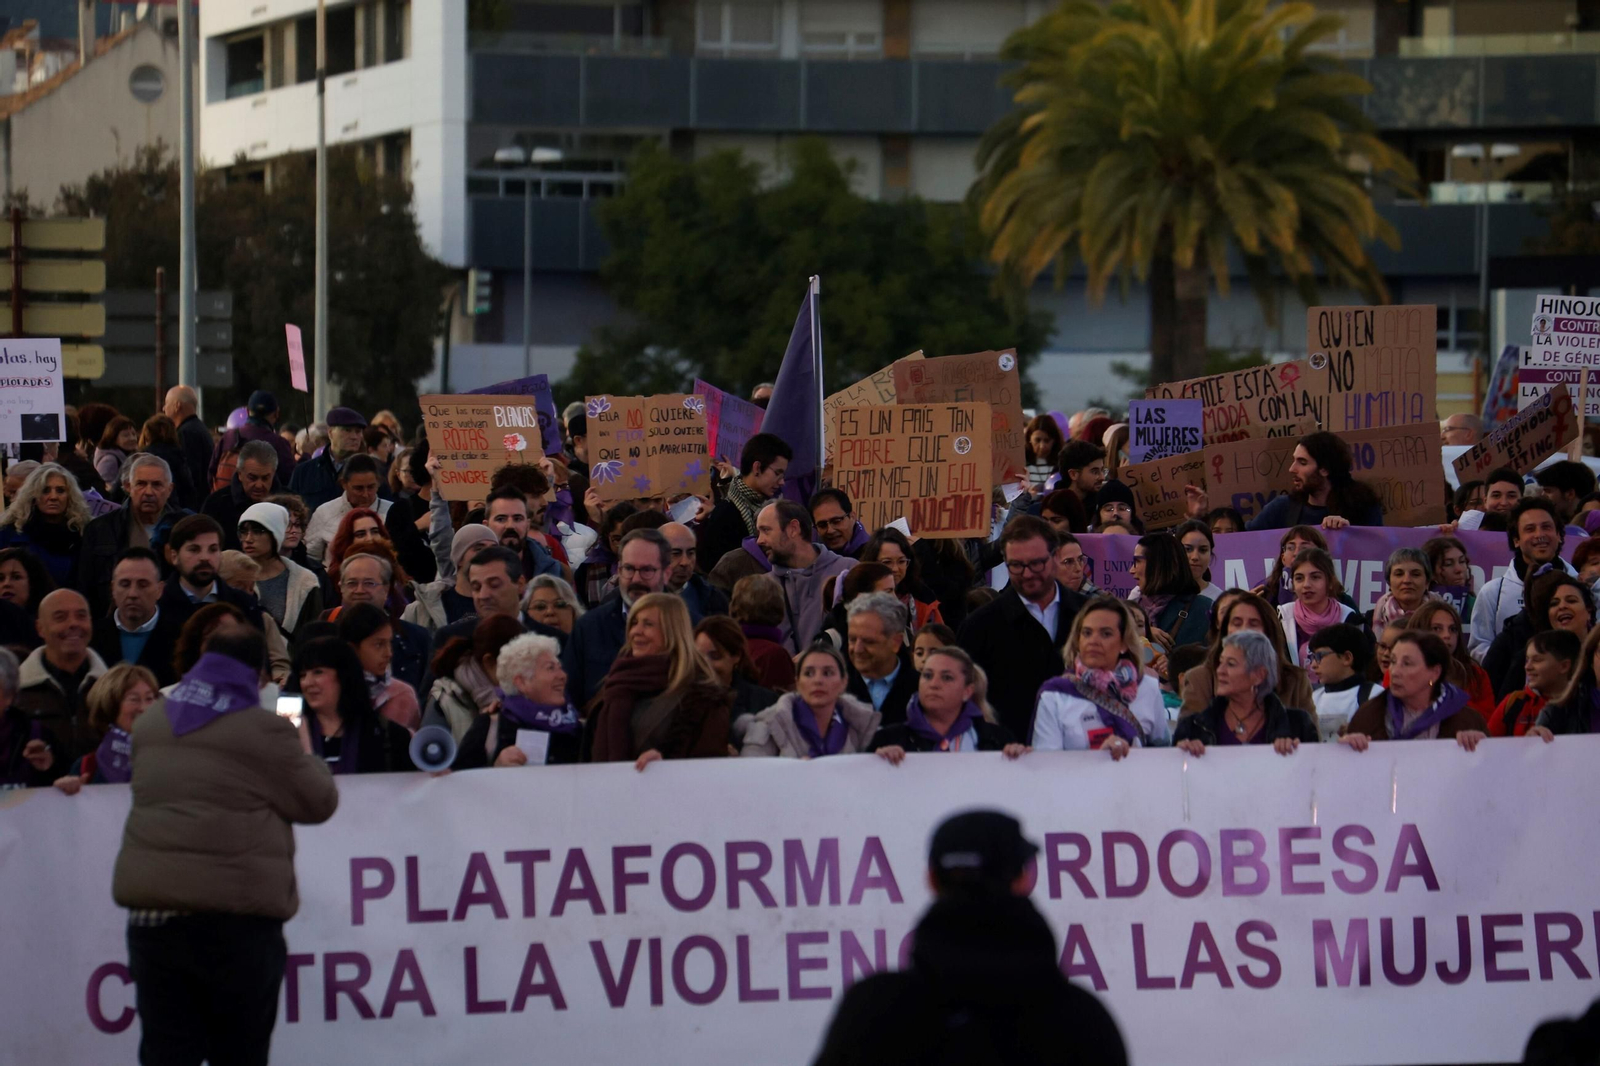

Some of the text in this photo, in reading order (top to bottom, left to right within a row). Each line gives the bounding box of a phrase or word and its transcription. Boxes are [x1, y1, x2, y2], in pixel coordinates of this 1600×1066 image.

[1319, 310, 1374, 349] QUIEN
[1536, 335, 1553, 346] LA
[35, 350, 57, 373] hay
[1543, 350, 1561, 363] DE
[1328, 351, 1355, 393] NO
[1546, 371, 1597, 383] CONTA
[1522, 386, 1539, 397] LA
[626, 409, 643, 429] NO
[650, 407, 695, 423] QUIERE
[840, 408, 859, 436] ES
[870, 409, 892, 435] UN
[946, 406, 975, 433] TAN
[1135, 407, 1166, 424] LAS
[443, 427, 489, 451] ROJAS
[1135, 427, 1200, 447] MUJERES
[840, 434, 949, 468] POBRE QUE
[441, 470, 490, 485] SANGRE
[919, 466, 939, 498] UN
[947, 462, 982, 493] GOL
[350, 824, 1441, 926] PLATAFORMA RDOBESA
[85, 950, 437, 1034] CTRA
[463, 943, 568, 1015] LA
[591, 929, 916, 1010] VIOLEN
[1057, 923, 1109, 991] A
[1131, 920, 1283, 990] LAS
